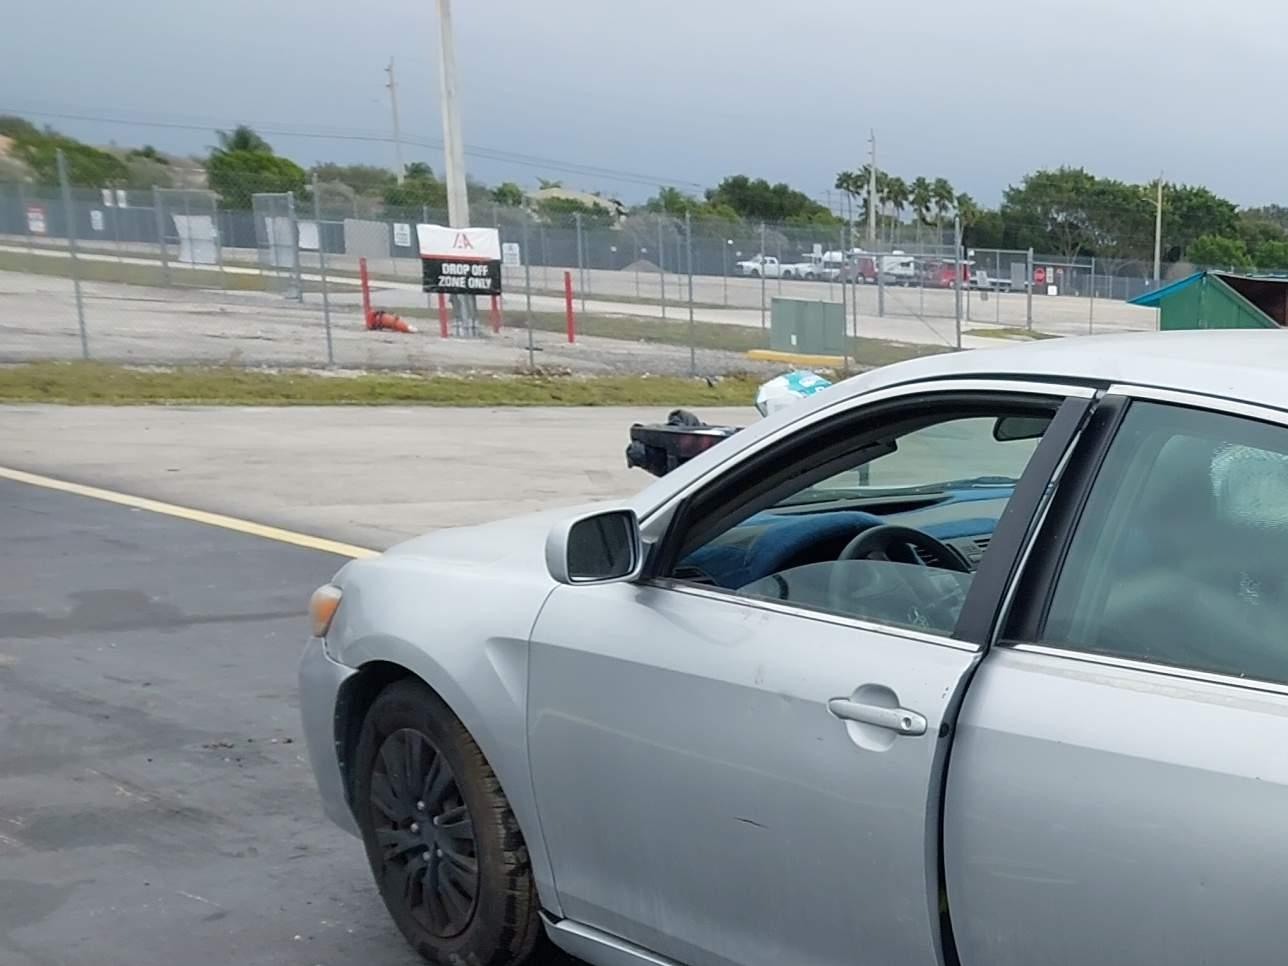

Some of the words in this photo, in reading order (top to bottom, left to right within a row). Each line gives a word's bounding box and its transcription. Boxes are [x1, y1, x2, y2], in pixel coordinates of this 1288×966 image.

[441, 263, 470, 275] DROP
[471, 265, 489, 277] OFF
[437, 275, 467, 288] ZONE
[467, 277, 492, 289] ONLY
